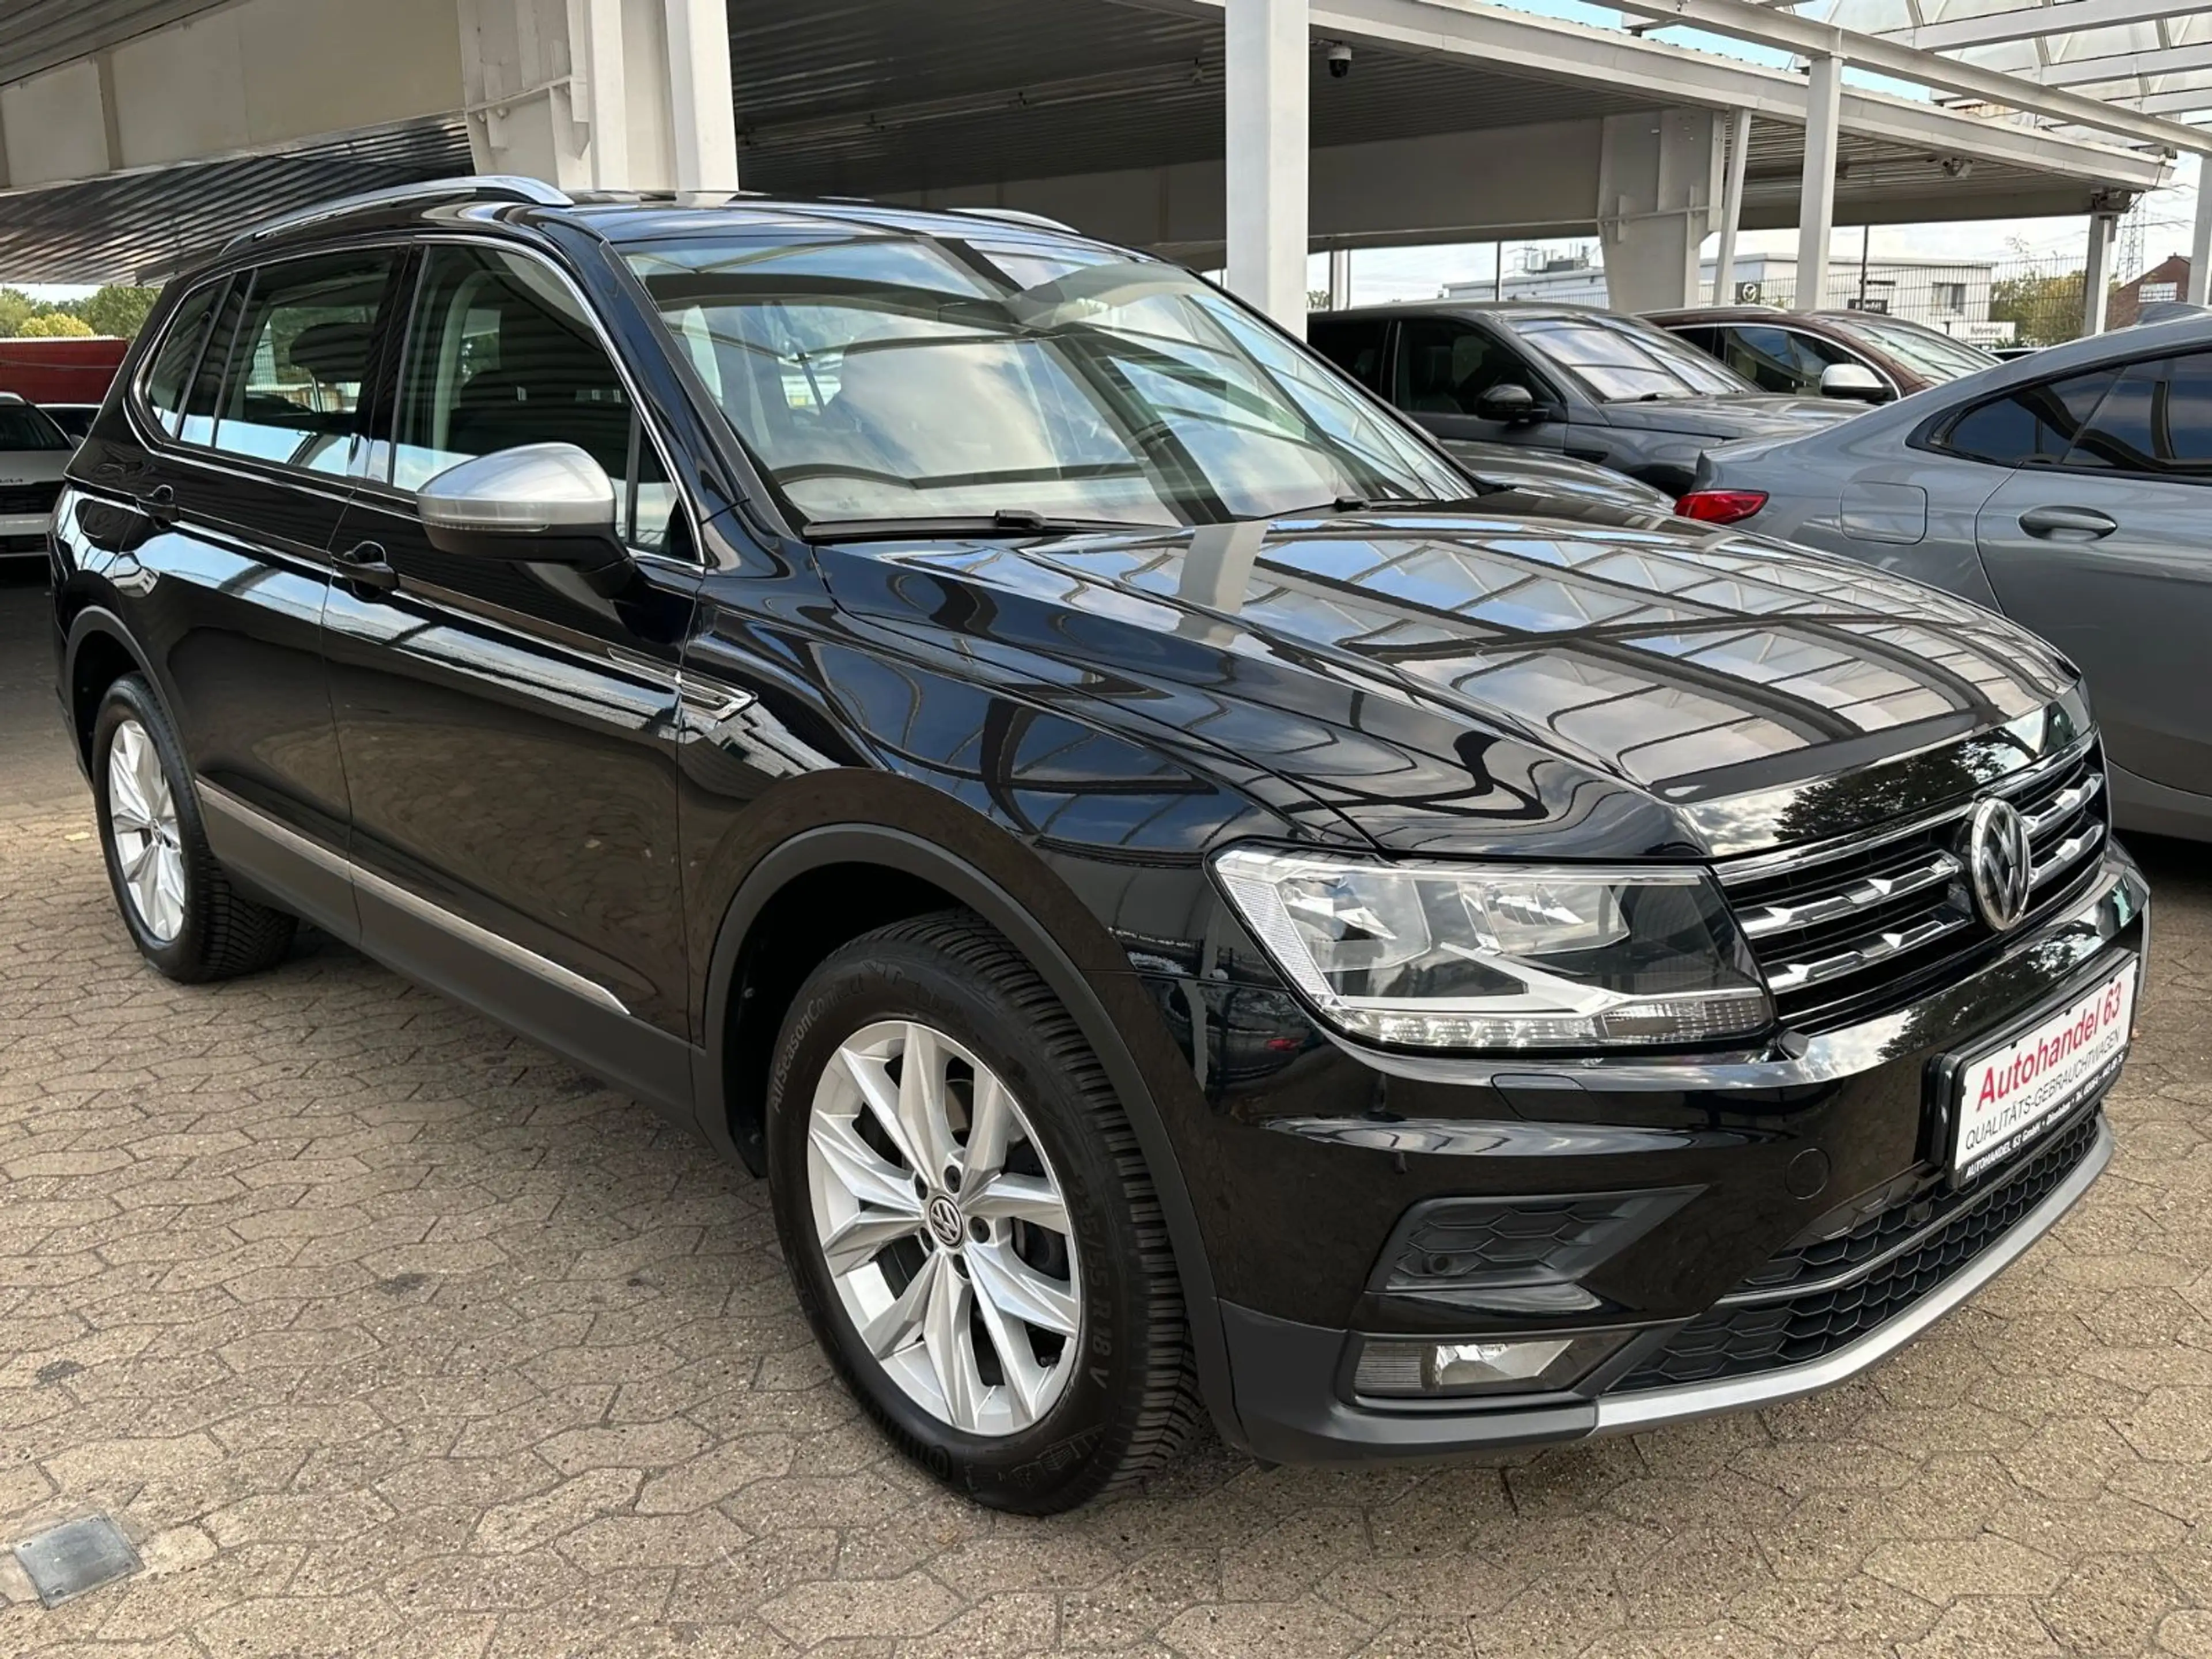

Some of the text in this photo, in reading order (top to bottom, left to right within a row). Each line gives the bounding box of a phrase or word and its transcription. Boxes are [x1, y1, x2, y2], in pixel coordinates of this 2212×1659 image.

[1975, 997, 2101, 1112] Autohandel
[2103, 981, 2122, 1026] 63
[1965, 1141, 2011, 1179] AUTOHANDEL
